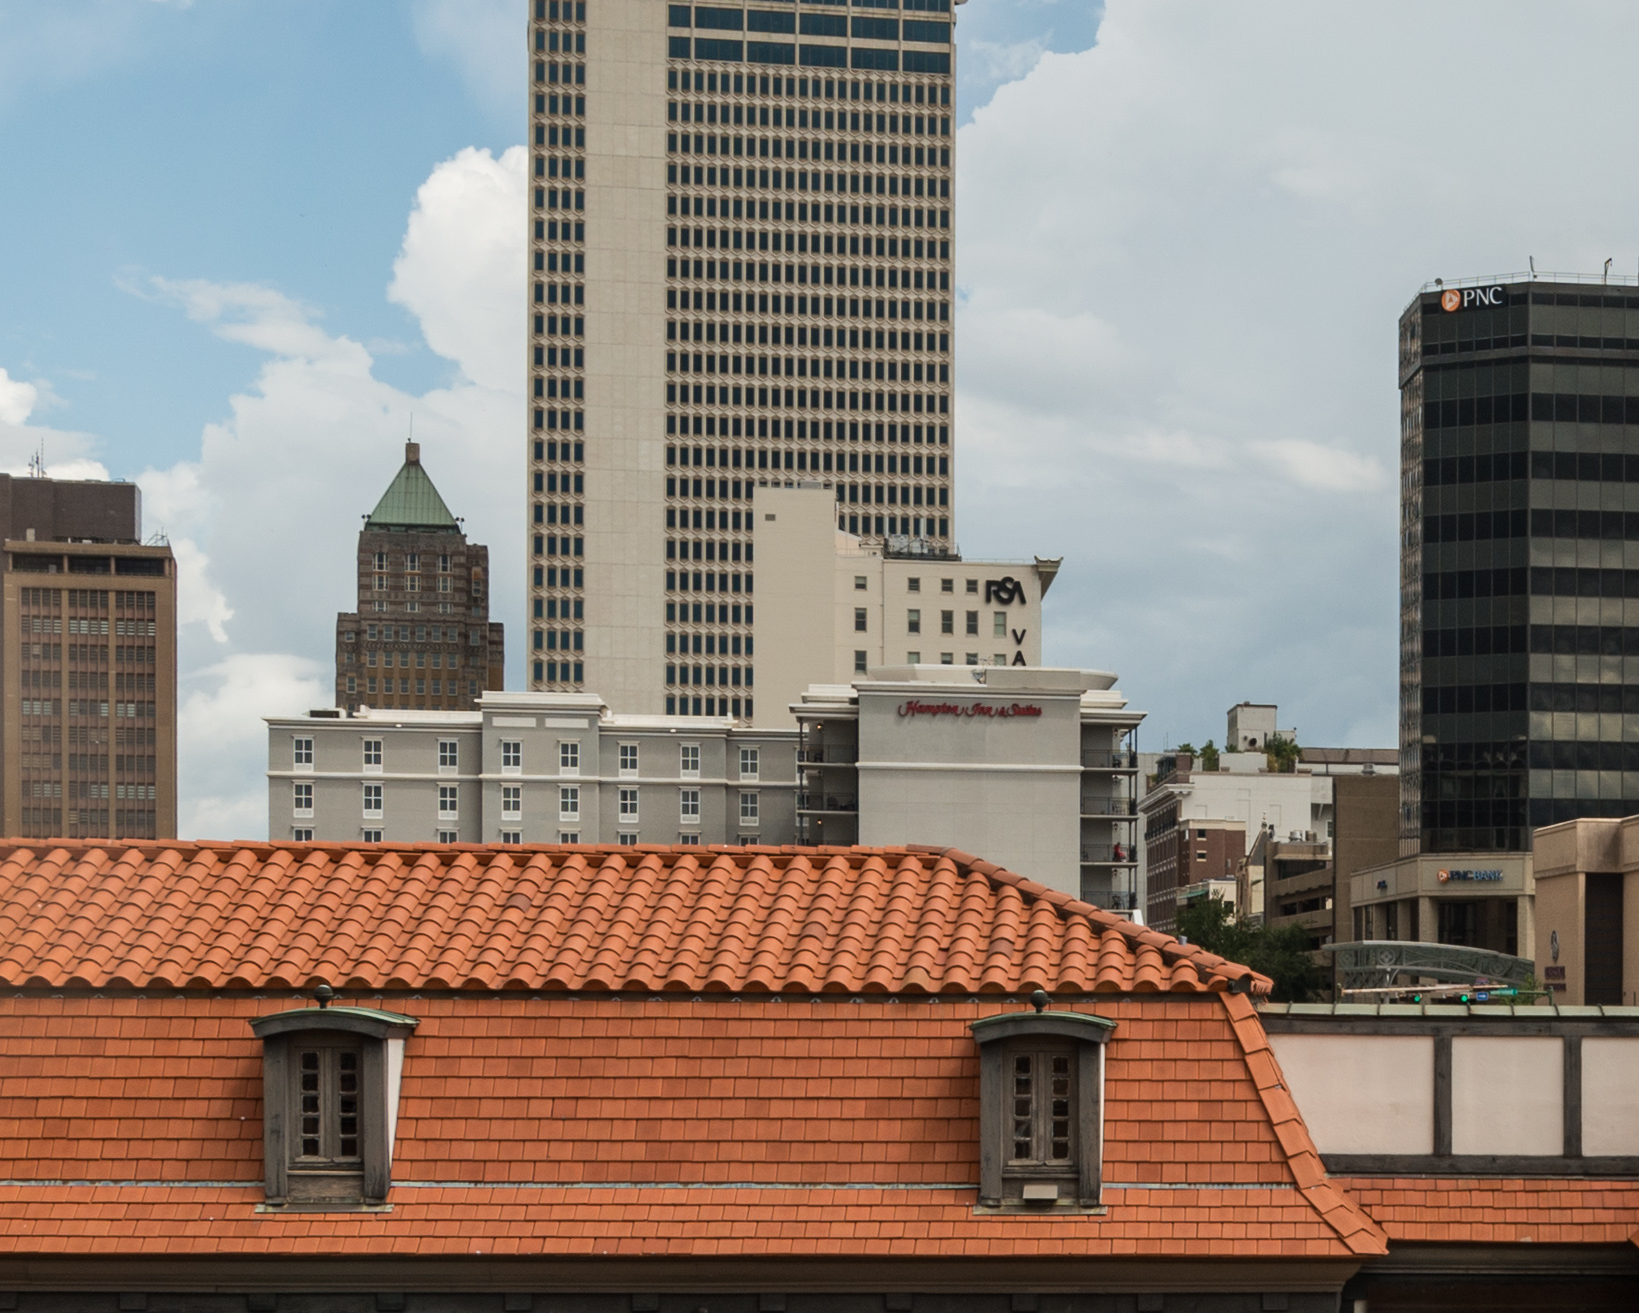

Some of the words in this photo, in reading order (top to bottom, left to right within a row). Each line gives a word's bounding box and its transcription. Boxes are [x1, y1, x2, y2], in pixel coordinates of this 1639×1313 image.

[1462, 286, 1503, 308] PNC
[985, 576, 1027, 606] RSA
[897, 699, 965, 718] Hampton
[965, 702, 999, 718] Inn
[1006, 702, 1043, 718] Suites
[1473, 869, 1504, 881] BANK
